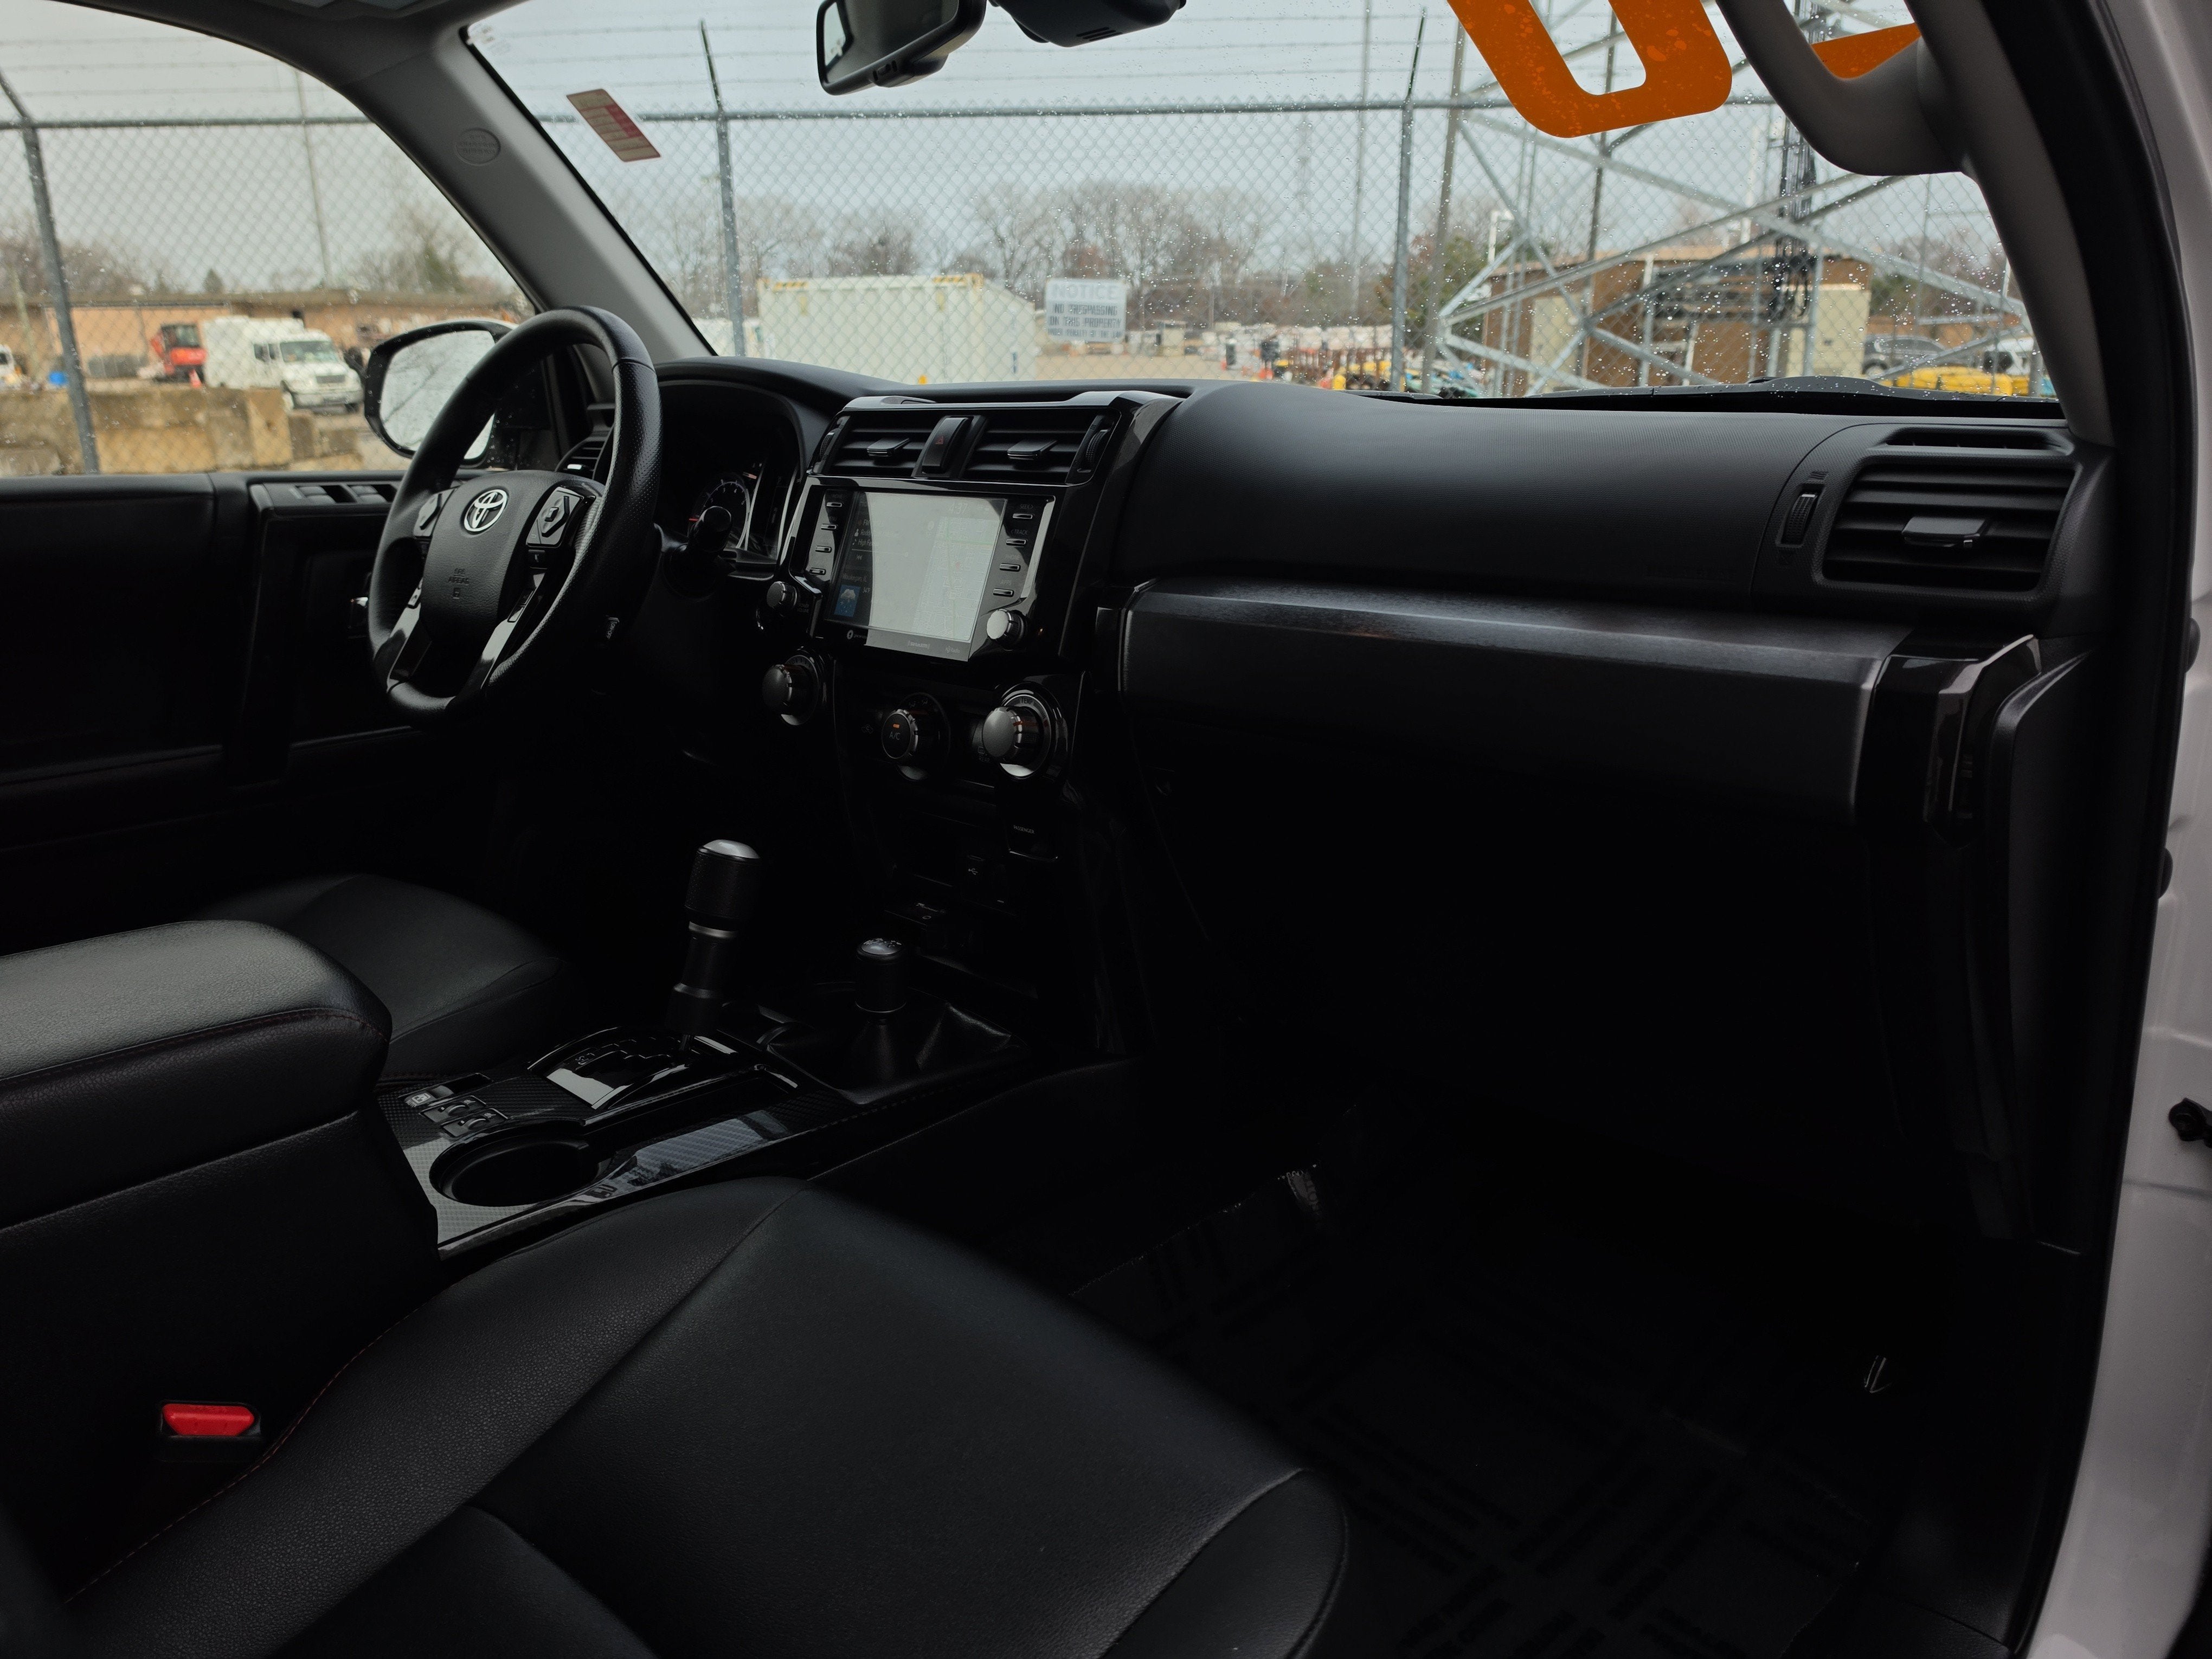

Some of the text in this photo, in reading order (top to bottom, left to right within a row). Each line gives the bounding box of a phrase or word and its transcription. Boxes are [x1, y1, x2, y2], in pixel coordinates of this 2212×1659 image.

[1051, 283, 1119, 300] NOTICE
[1054, 303, 1118, 316] NO TRESPASSING
[1050, 316, 1121, 328] ON THIS PROPERTY
[948, 500, 968, 515] 4:37
[889, 731, 901, 741] A/C
[1013, 824, 1036, 834] PASSENGER
